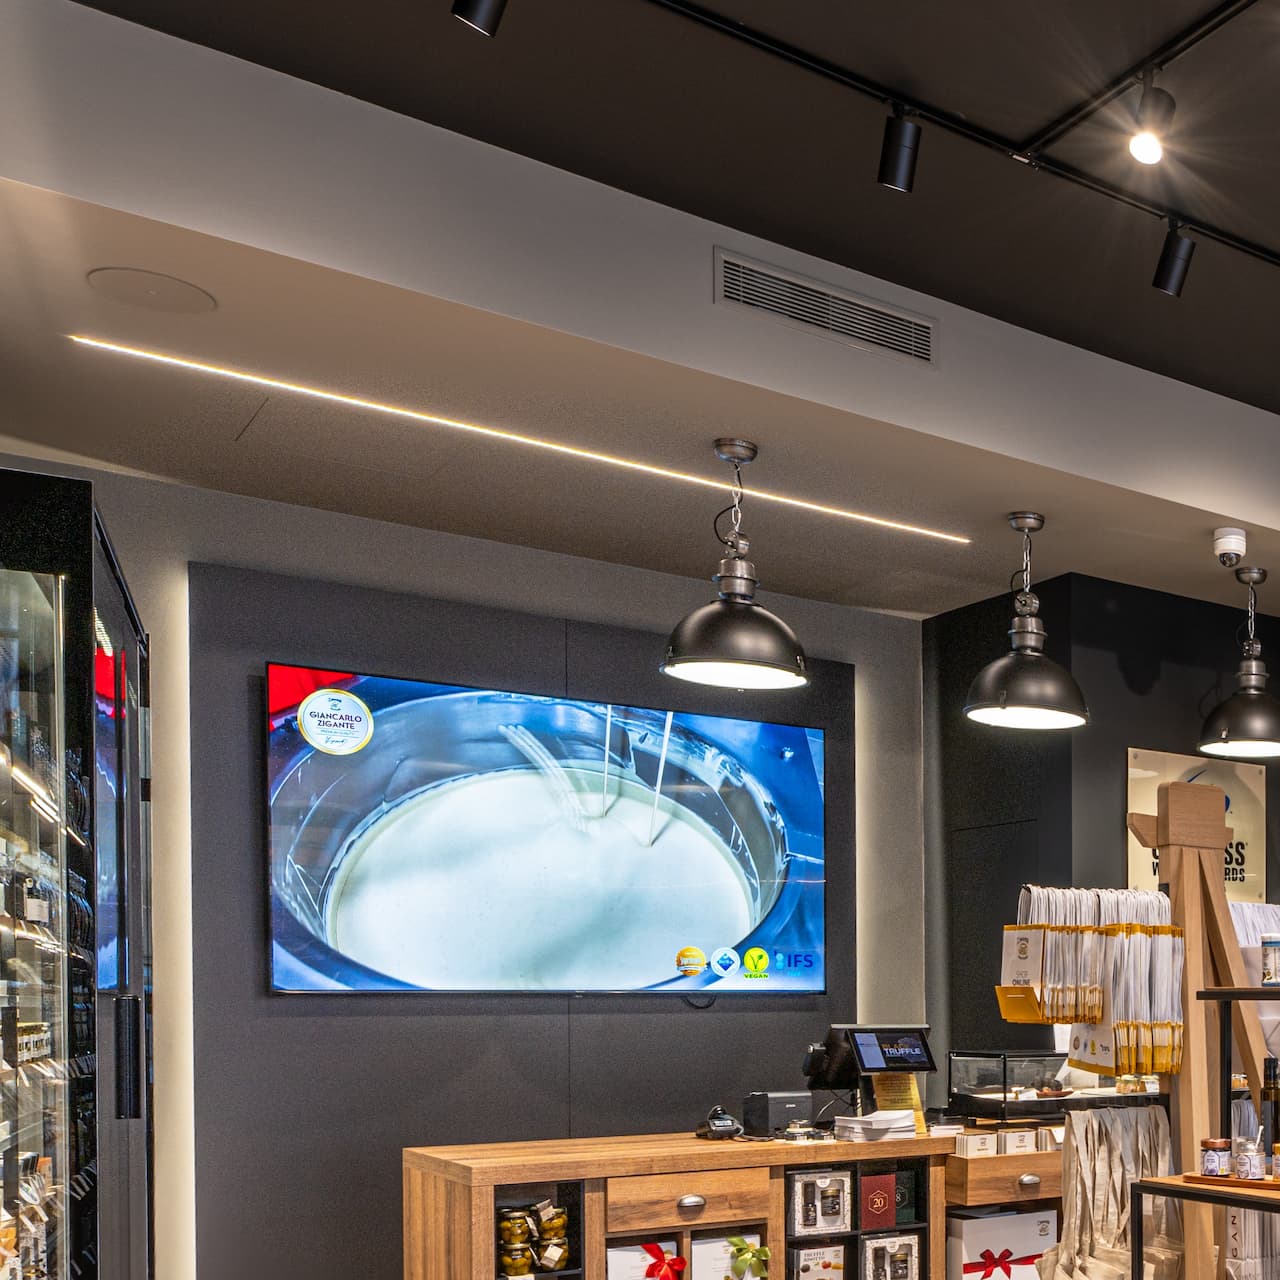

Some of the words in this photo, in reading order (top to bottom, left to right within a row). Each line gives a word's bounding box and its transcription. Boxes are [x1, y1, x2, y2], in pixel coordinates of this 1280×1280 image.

[309, 711, 362, 723] GIANCARLO
[317, 719, 355, 730] ZIGANTE
[787, 954, 813, 968] IFS
[883, 1048, 921, 1056] TRUFFLE
[873, 1198, 884, 1208] 20
